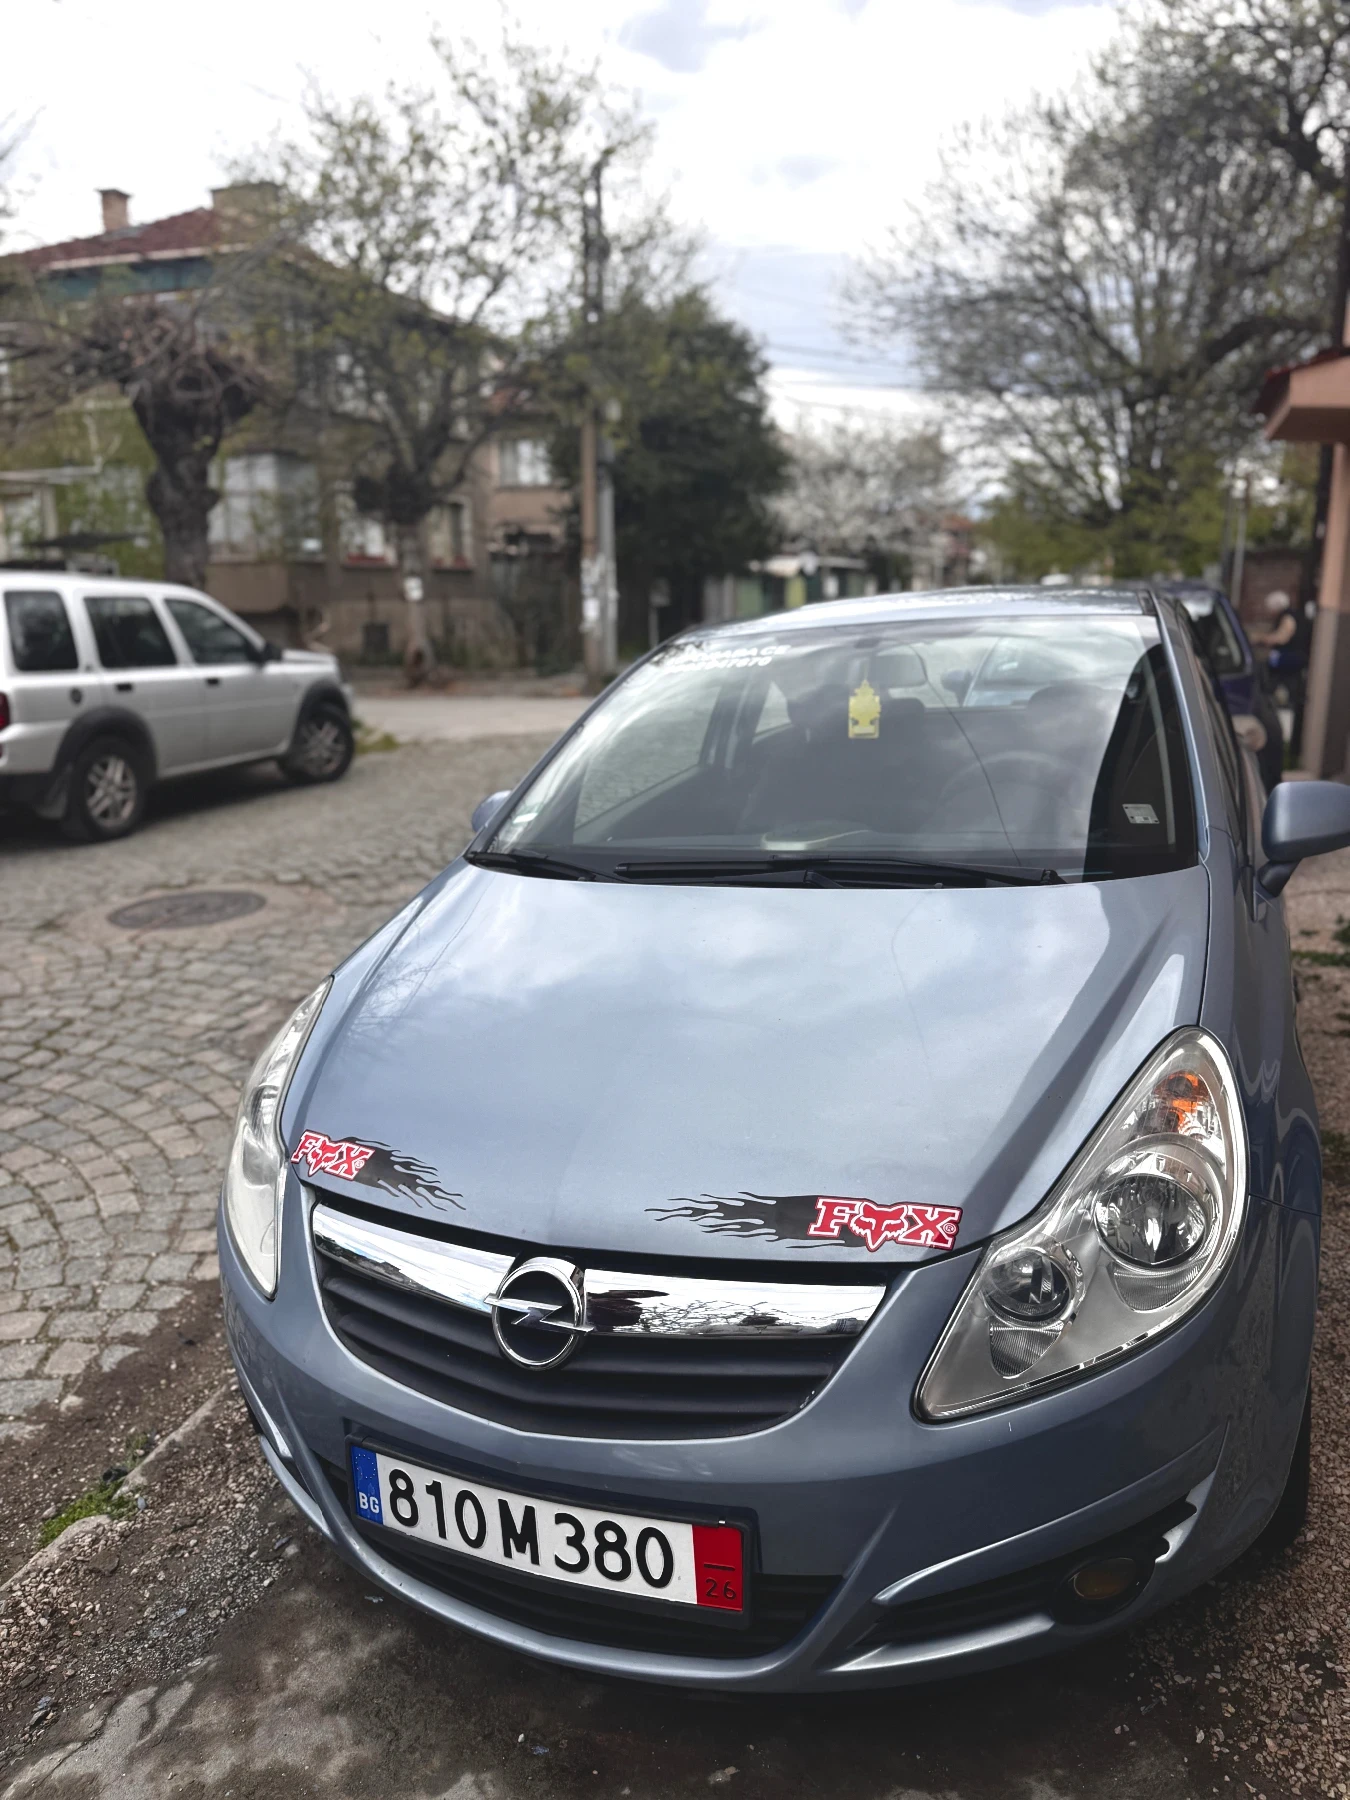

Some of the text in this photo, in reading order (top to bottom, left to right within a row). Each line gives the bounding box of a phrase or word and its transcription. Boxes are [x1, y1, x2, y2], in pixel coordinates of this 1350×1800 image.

[359, 1491, 380, 1514] BG
[388, 1468, 487, 1549] 810
[554, 1512, 674, 1589] 380
[705, 1577, 737, 1601] 26
